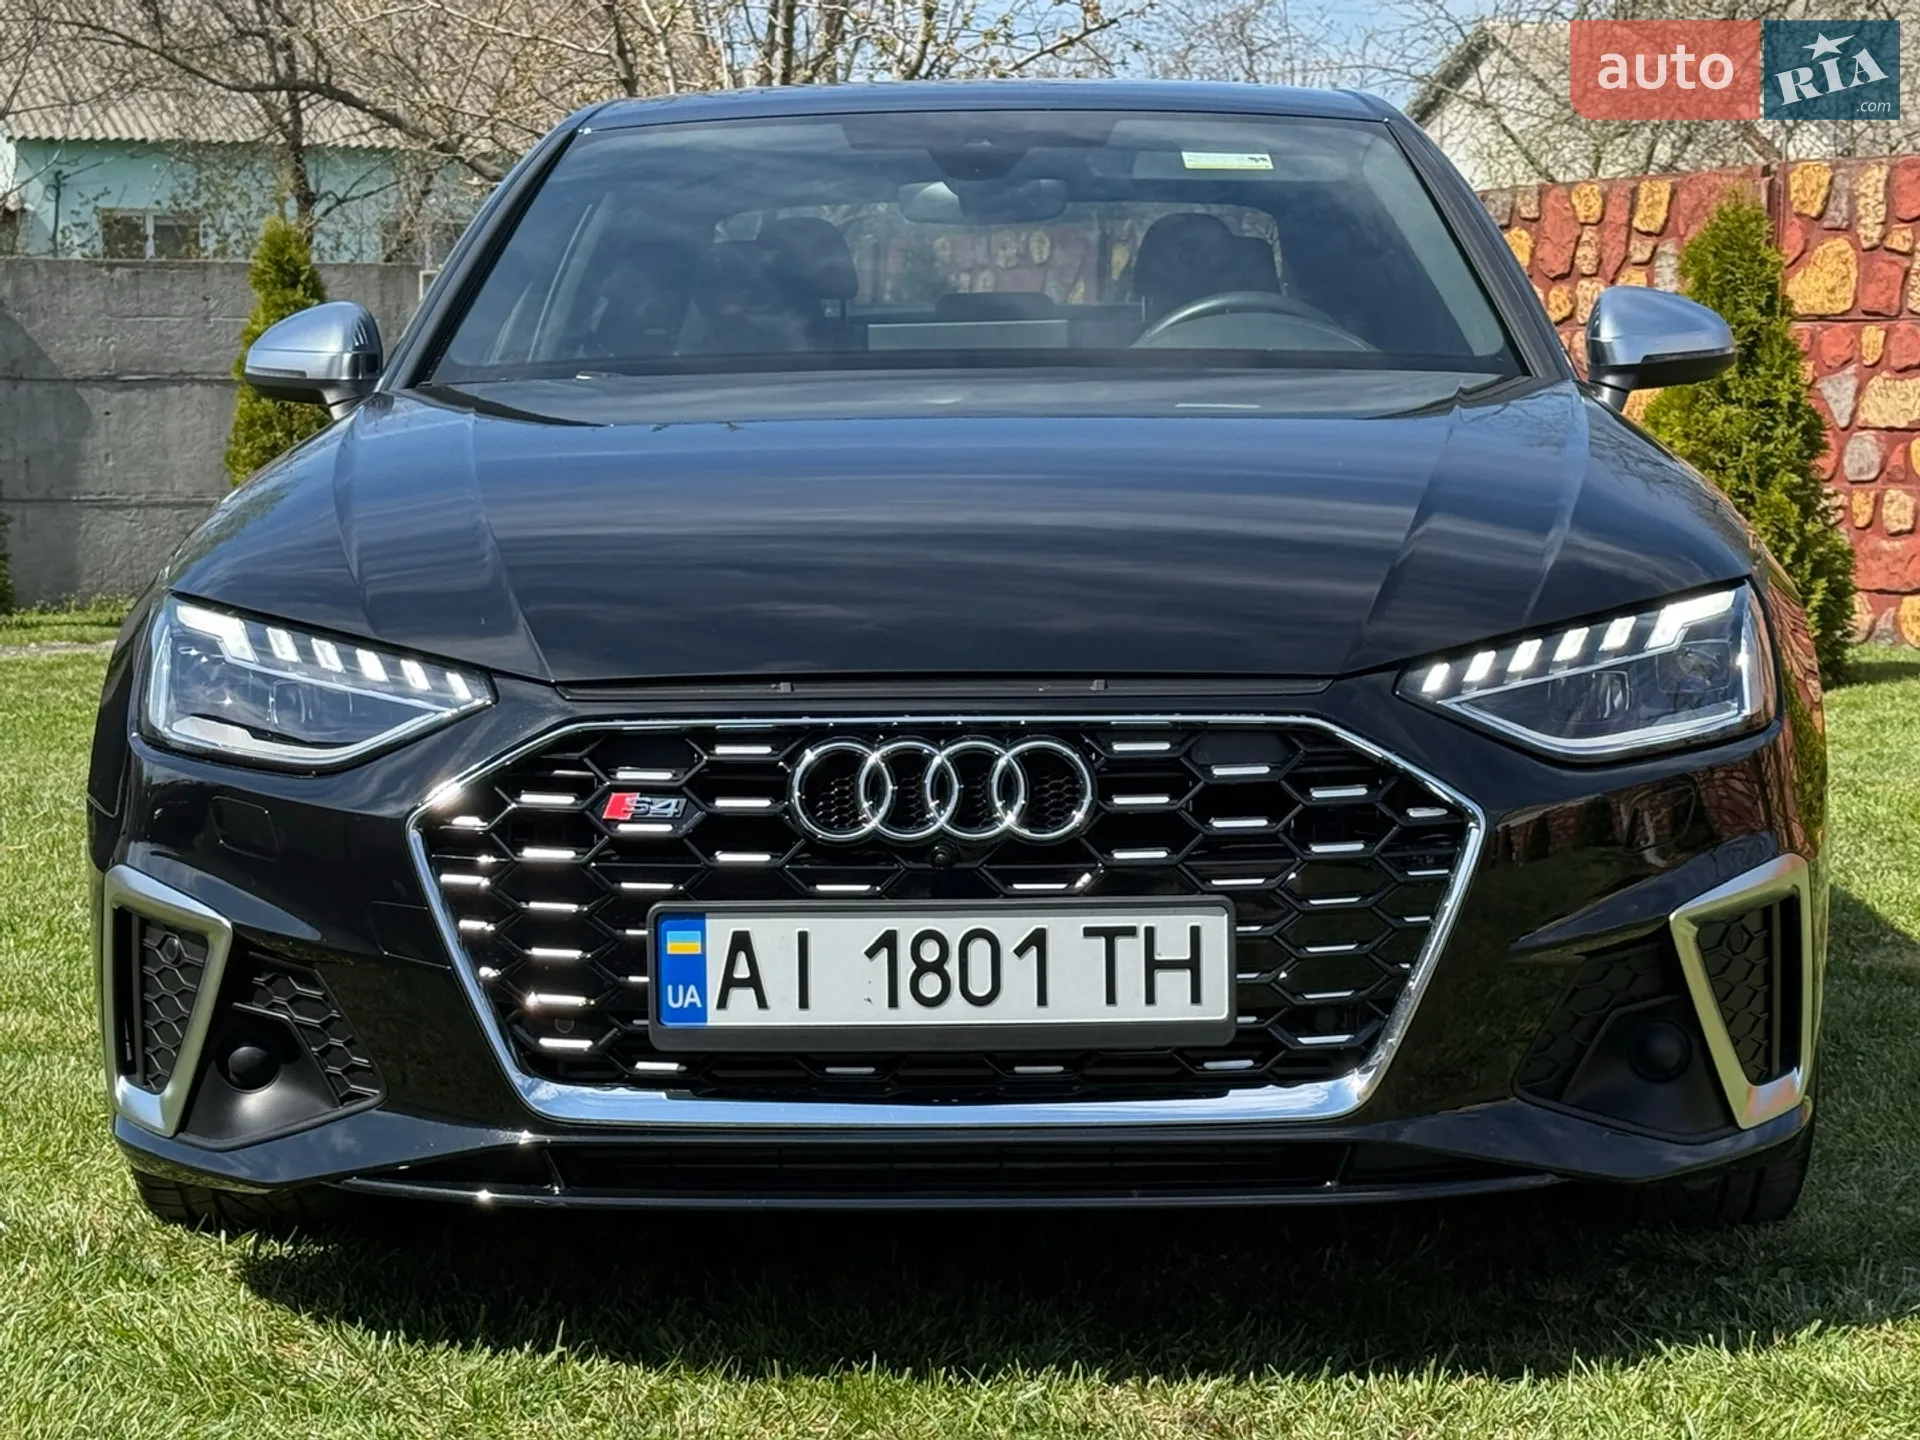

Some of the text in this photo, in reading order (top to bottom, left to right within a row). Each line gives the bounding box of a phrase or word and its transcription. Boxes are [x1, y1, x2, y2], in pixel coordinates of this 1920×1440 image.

[716, 925, 1201, 1010] AI 1801 TH
[667, 984, 702, 1008] UA
